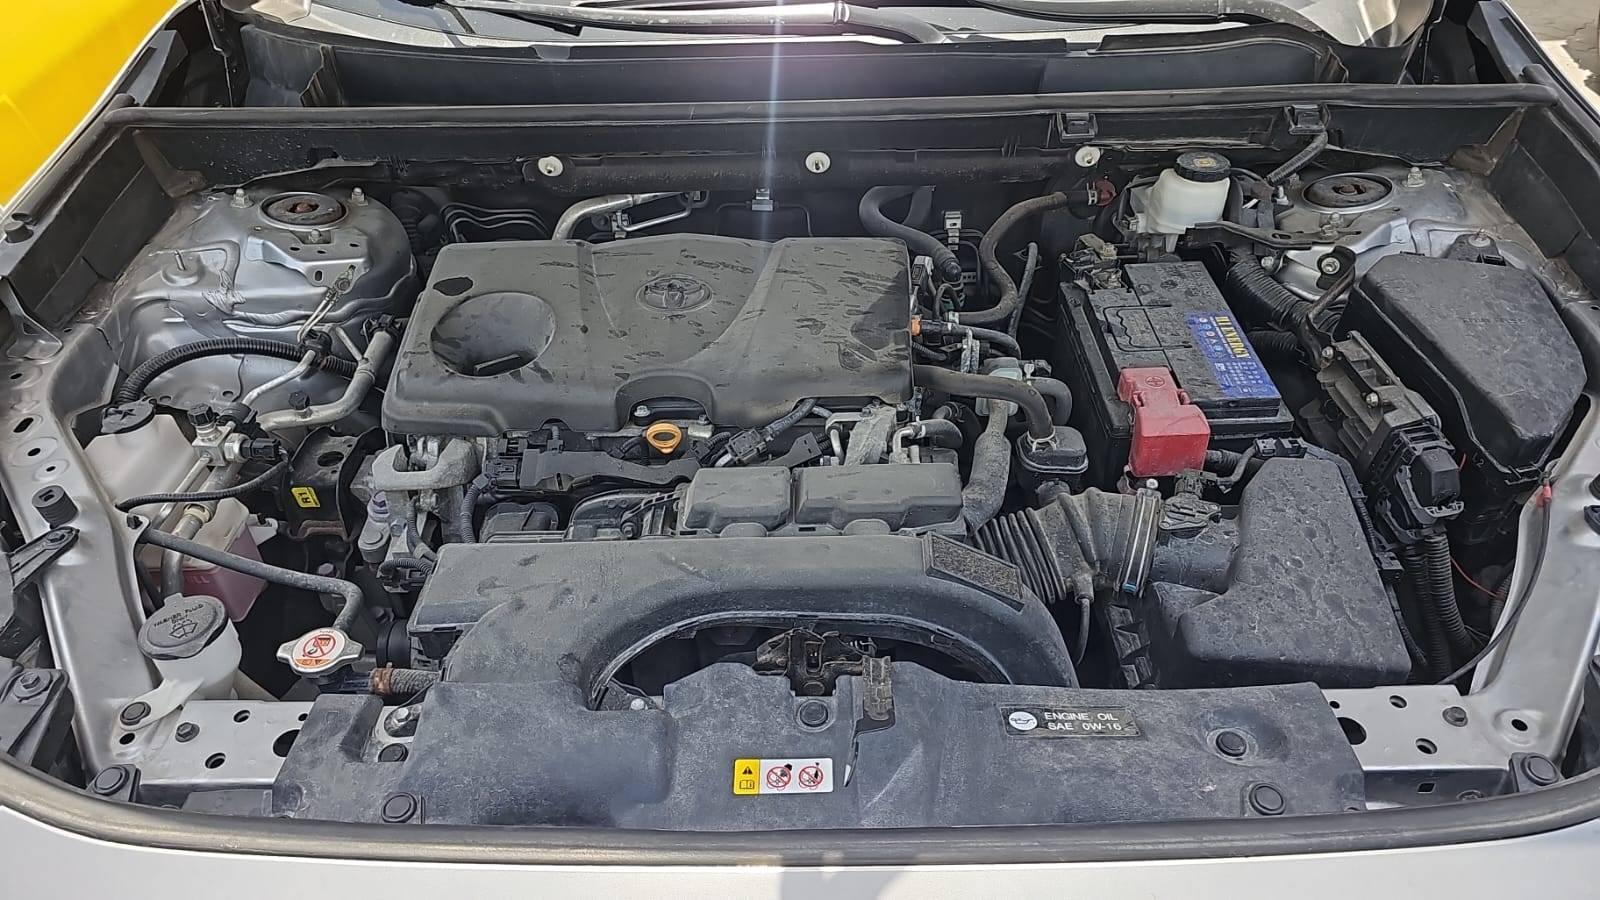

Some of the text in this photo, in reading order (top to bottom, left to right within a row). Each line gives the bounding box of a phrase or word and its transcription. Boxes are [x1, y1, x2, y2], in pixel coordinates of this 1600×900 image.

[1220, 326, 1252, 359] ENERGY
[298, 492, 311, 503] R1
[1044, 712, 1118, 721] ENGINE OIL
[1048, 722, 1122, 731] SAE 0W-16
